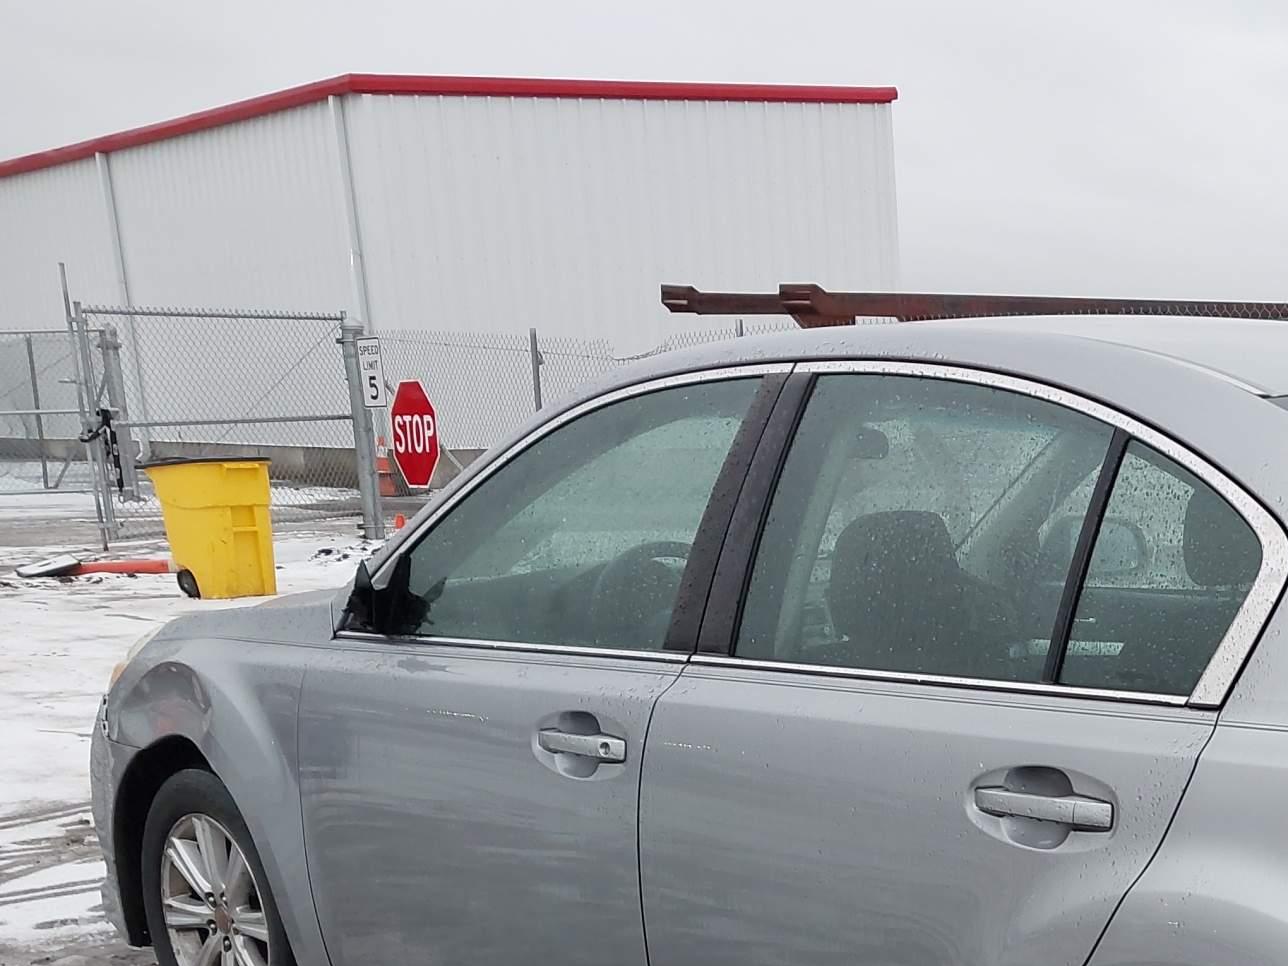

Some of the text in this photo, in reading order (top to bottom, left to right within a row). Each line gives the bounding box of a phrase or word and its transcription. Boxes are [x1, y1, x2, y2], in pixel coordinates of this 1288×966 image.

[359, 344, 379, 356] SPEED
[362, 360, 379, 371] LIMIT
[368, 375, 379, 401] 5
[394, 413, 435, 455] STOP
